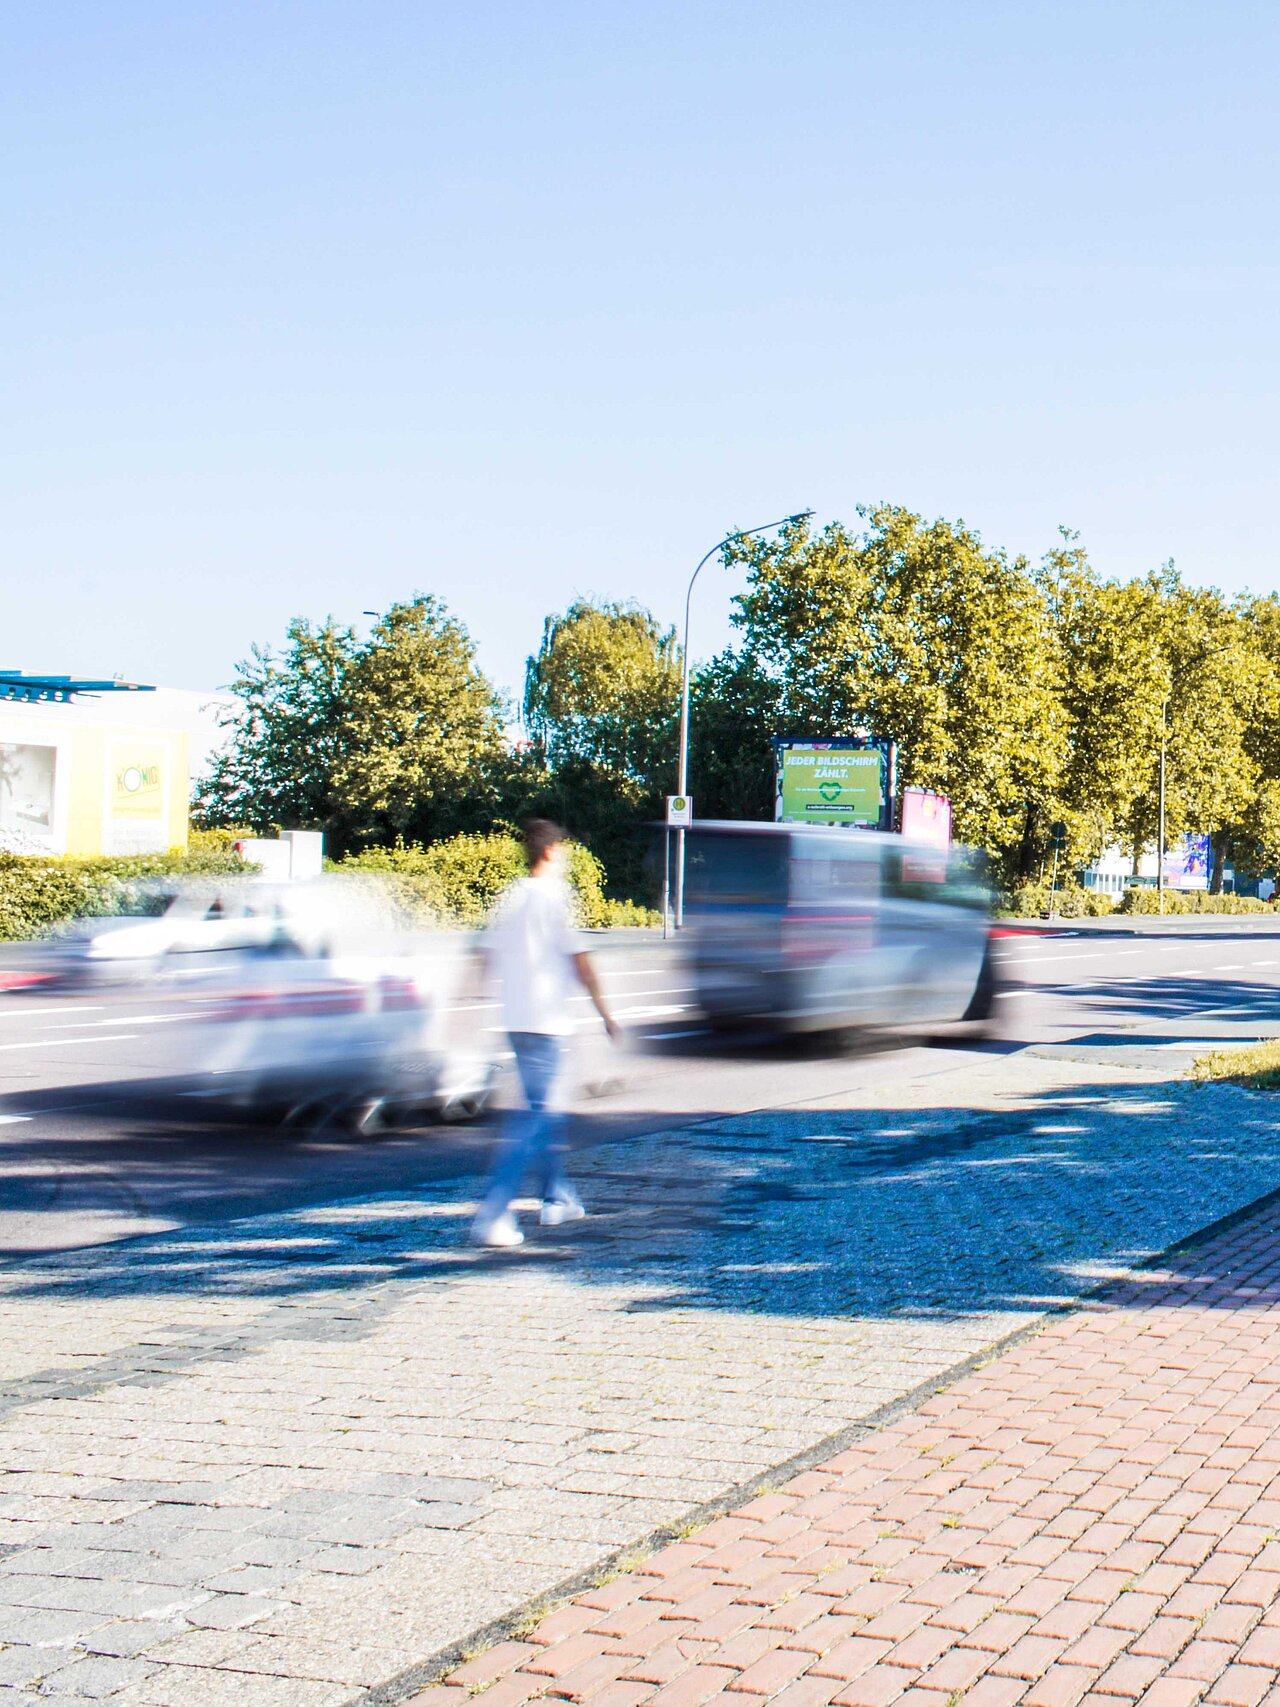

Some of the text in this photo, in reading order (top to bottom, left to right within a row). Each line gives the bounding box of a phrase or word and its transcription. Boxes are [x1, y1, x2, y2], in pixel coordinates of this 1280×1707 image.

[786, 756, 878, 766] JEDER BILDSCHIRM
[814, 766, 849, 778] ZÄHLT.
